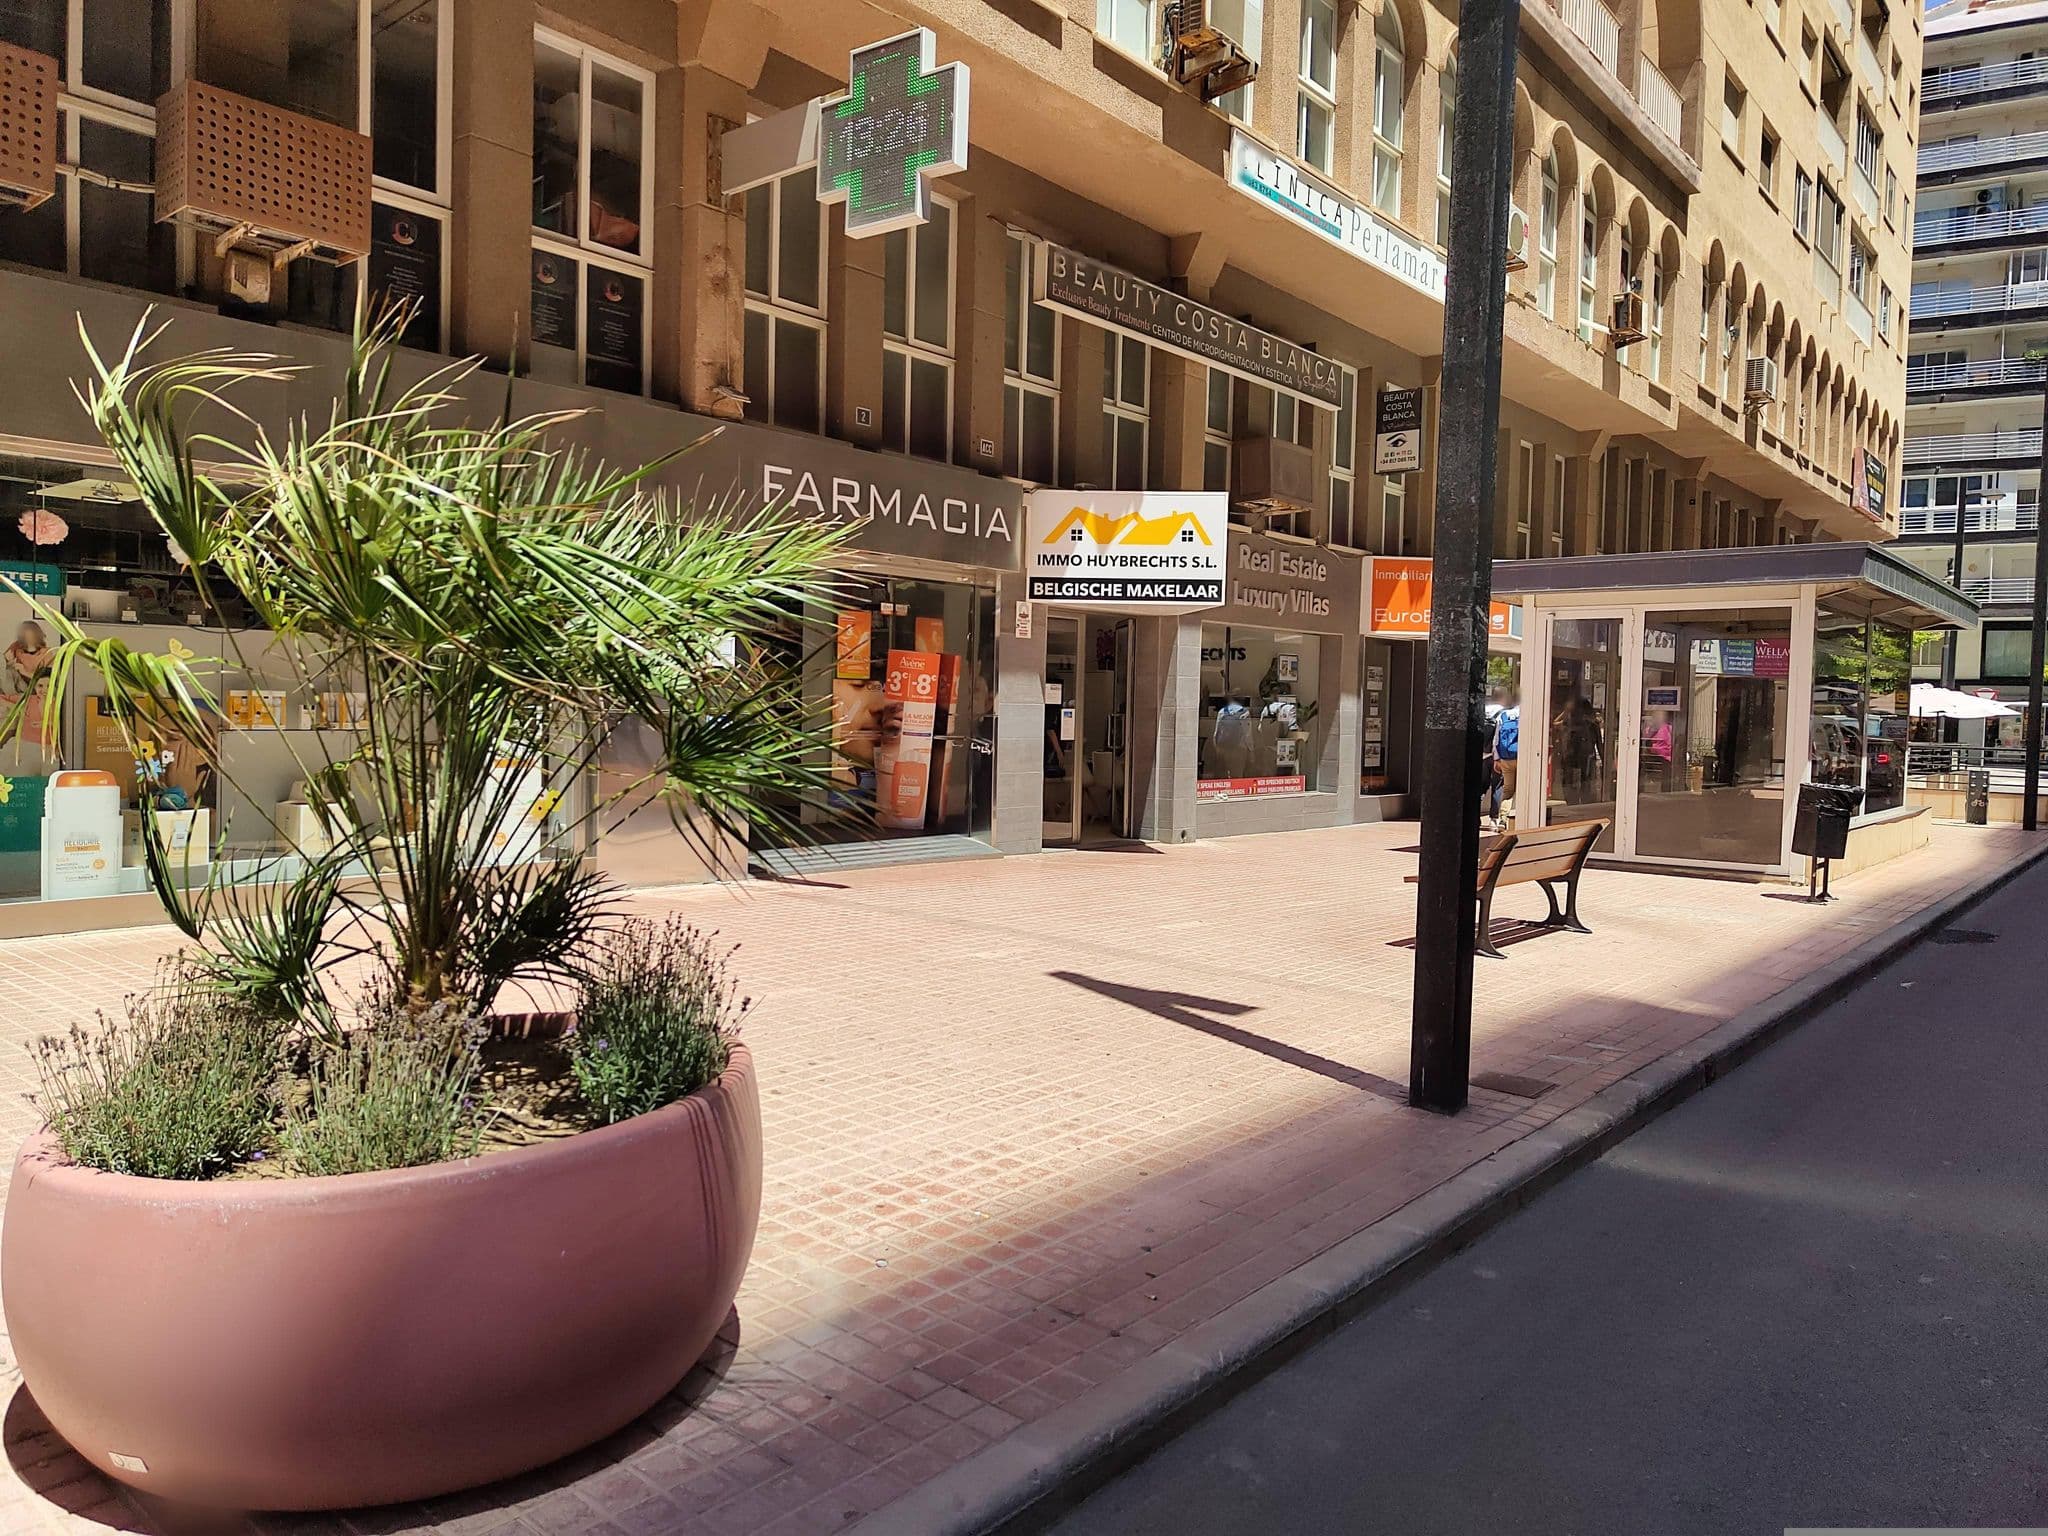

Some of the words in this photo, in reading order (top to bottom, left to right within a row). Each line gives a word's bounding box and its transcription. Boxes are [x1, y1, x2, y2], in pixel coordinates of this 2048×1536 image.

[839, 101, 928, 160] 13:26
[1243, 144, 1343, 226] LINICA
[1350, 208, 1438, 290] Perlamar
[1052, 282, 1087, 307] Exclusive
[1088, 296, 1112, 319] Beauty
[1114, 306, 1150, 331] Treatments
[1152, 323, 1181, 343] CENTRO
[1182, 335, 1192, 347] DE
[1053, 251, 1160, 315] BEAUTY
[1175, 303, 1248, 351] COSTA
[1261, 337, 1337, 386] BLANCA
[1383, 391, 1415, 402] BEAUTY
[1385, 401, 1412, 411] COSTA
[1382, 410, 1415, 422] BLANCA
[763, 464, 1012, 542] FARMACIA
[1037, 554, 1082, 567] IMMO
[1087, 555, 1188, 568] HUYBRECHTS
[1191, 556, 1217, 569] S.L.
[1238, 543, 1275, 574] Real
[1279, 550, 1327, 582] Estate
[1375, 569, 1432, 581] Inmobiliari
[1033, 582, 1123, 597] BELGISCHE
[1126, 583, 1218, 598] MAKELAAR
[1233, 580, 1288, 616] Luxury
[1290, 588, 1330, 616] Villas
[1755, 646, 1790, 657] WELLA
[900, 656, 926, 669] Avène
[96, 745, 133, 753] Sensatio
